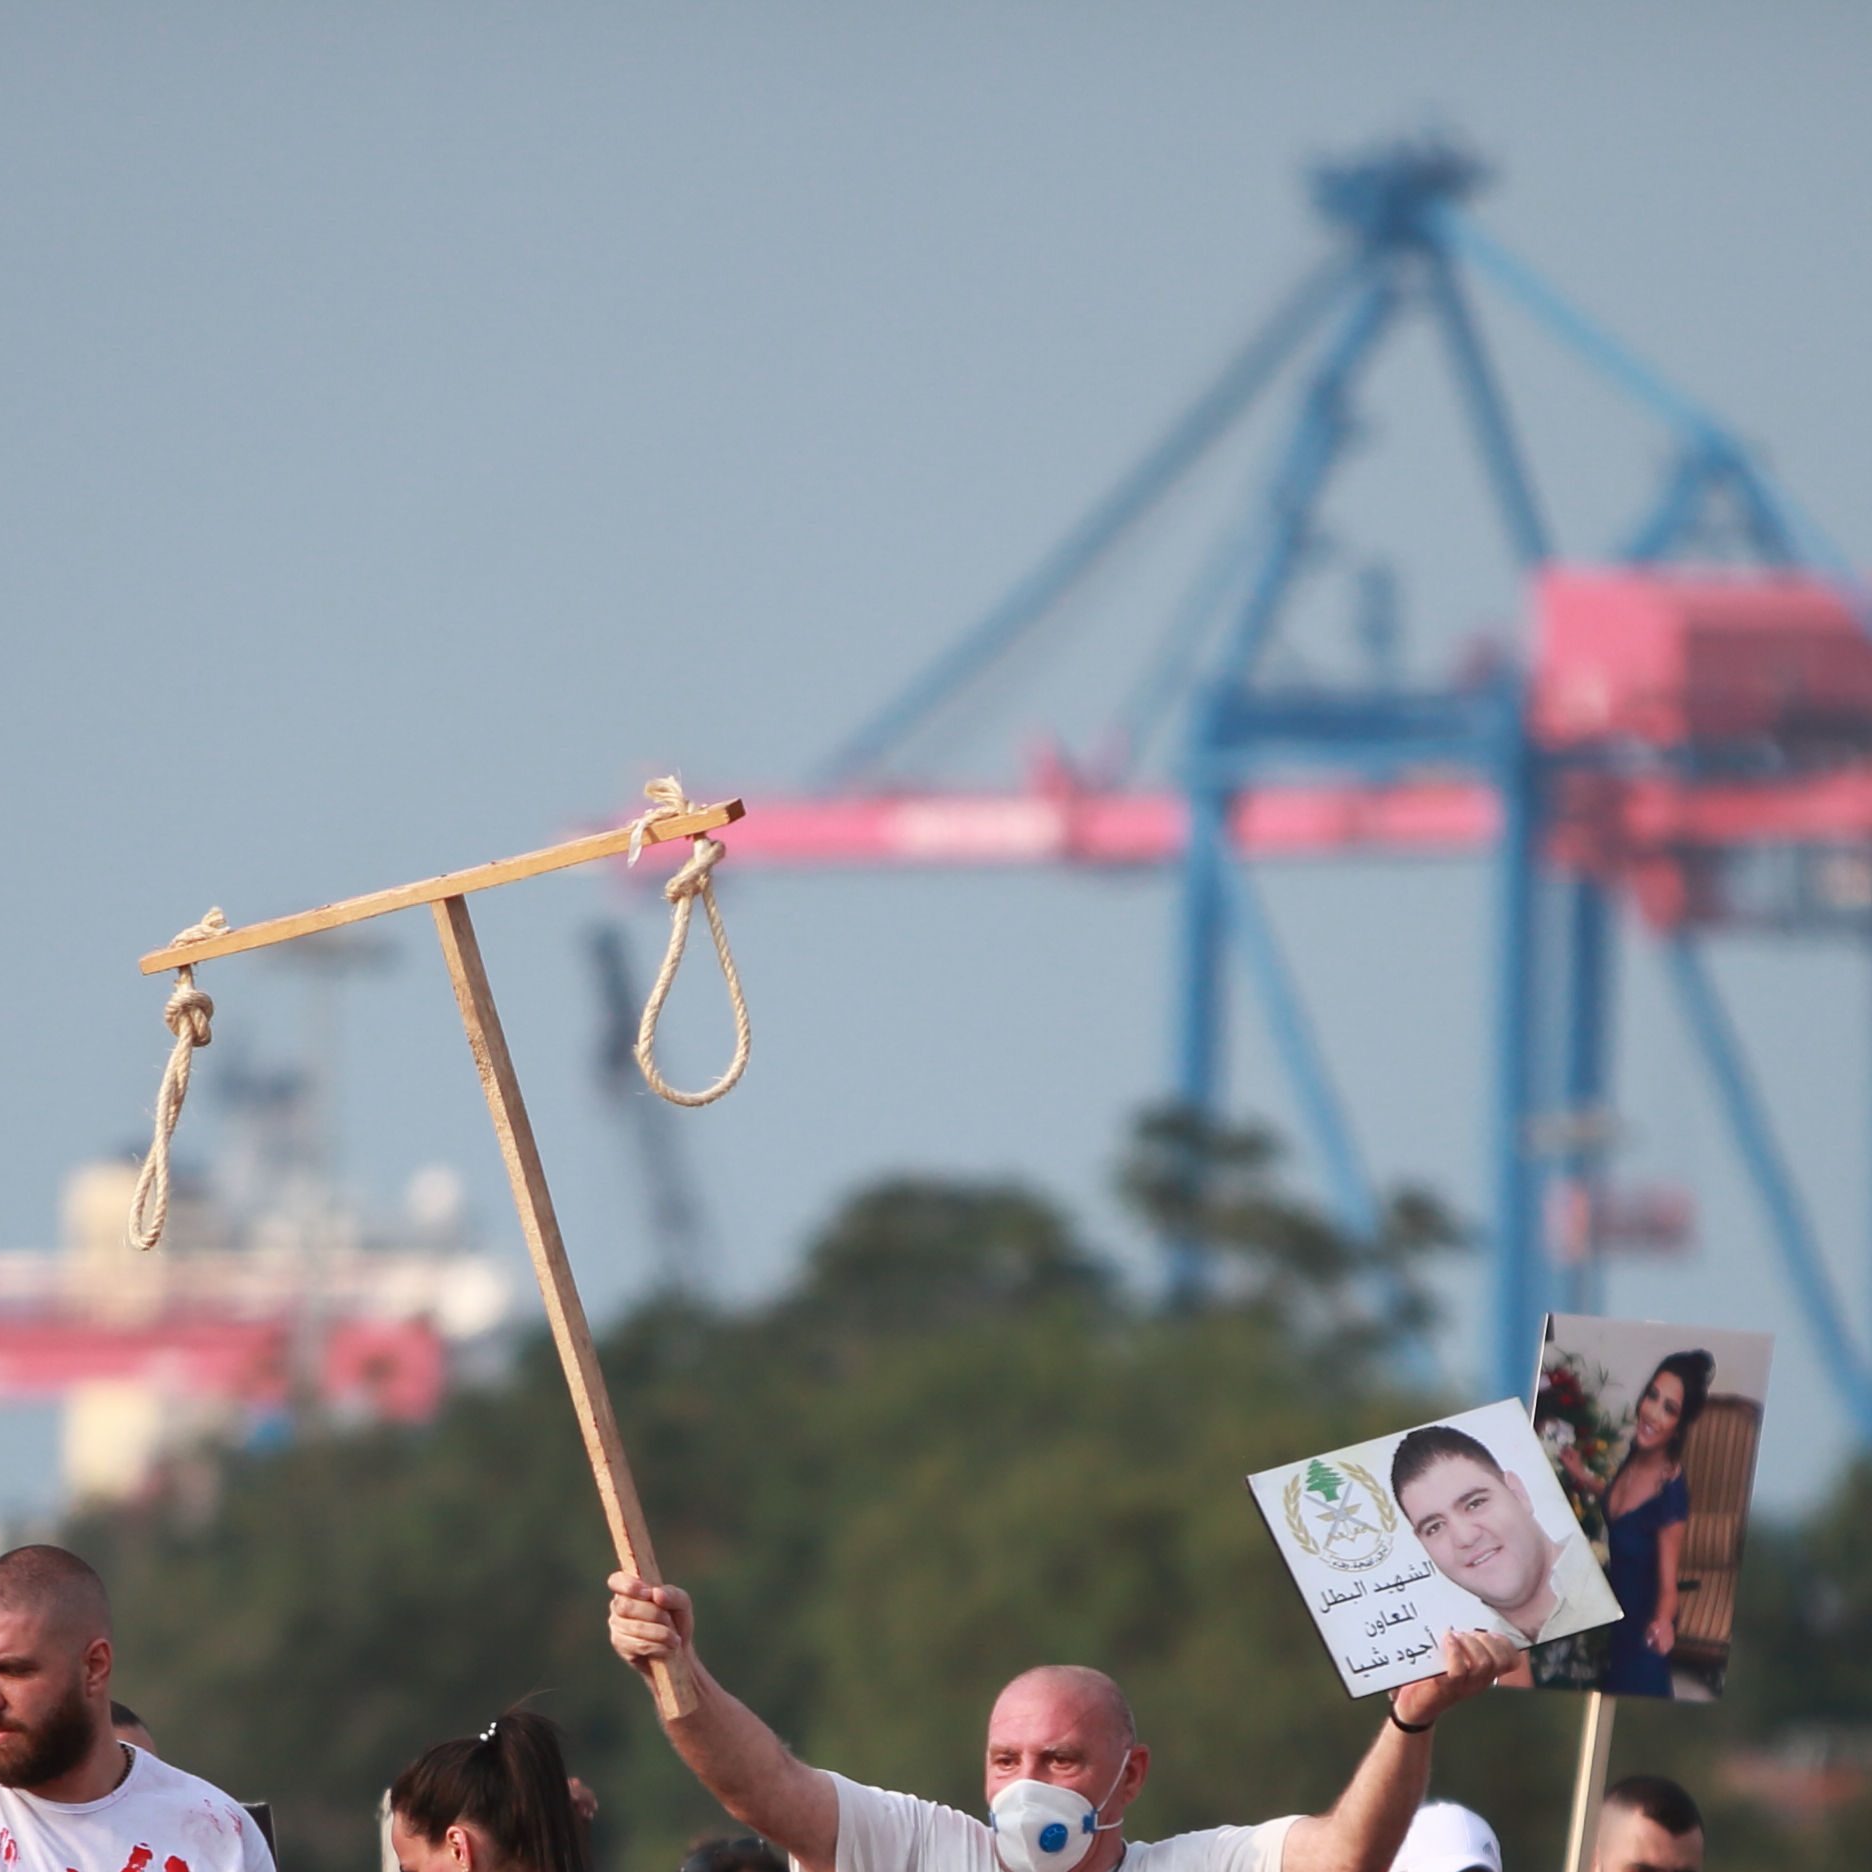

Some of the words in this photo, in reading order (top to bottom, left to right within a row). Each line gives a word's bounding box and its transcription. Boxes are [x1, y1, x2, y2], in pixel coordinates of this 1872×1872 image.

[1373, 1560, 1437, 1593] الشهيد
[1319, 1579, 1368, 1614] البطل
[1364, 1601, 1419, 1638] المعاون
[1396, 1625, 1439, 1665] أجود
